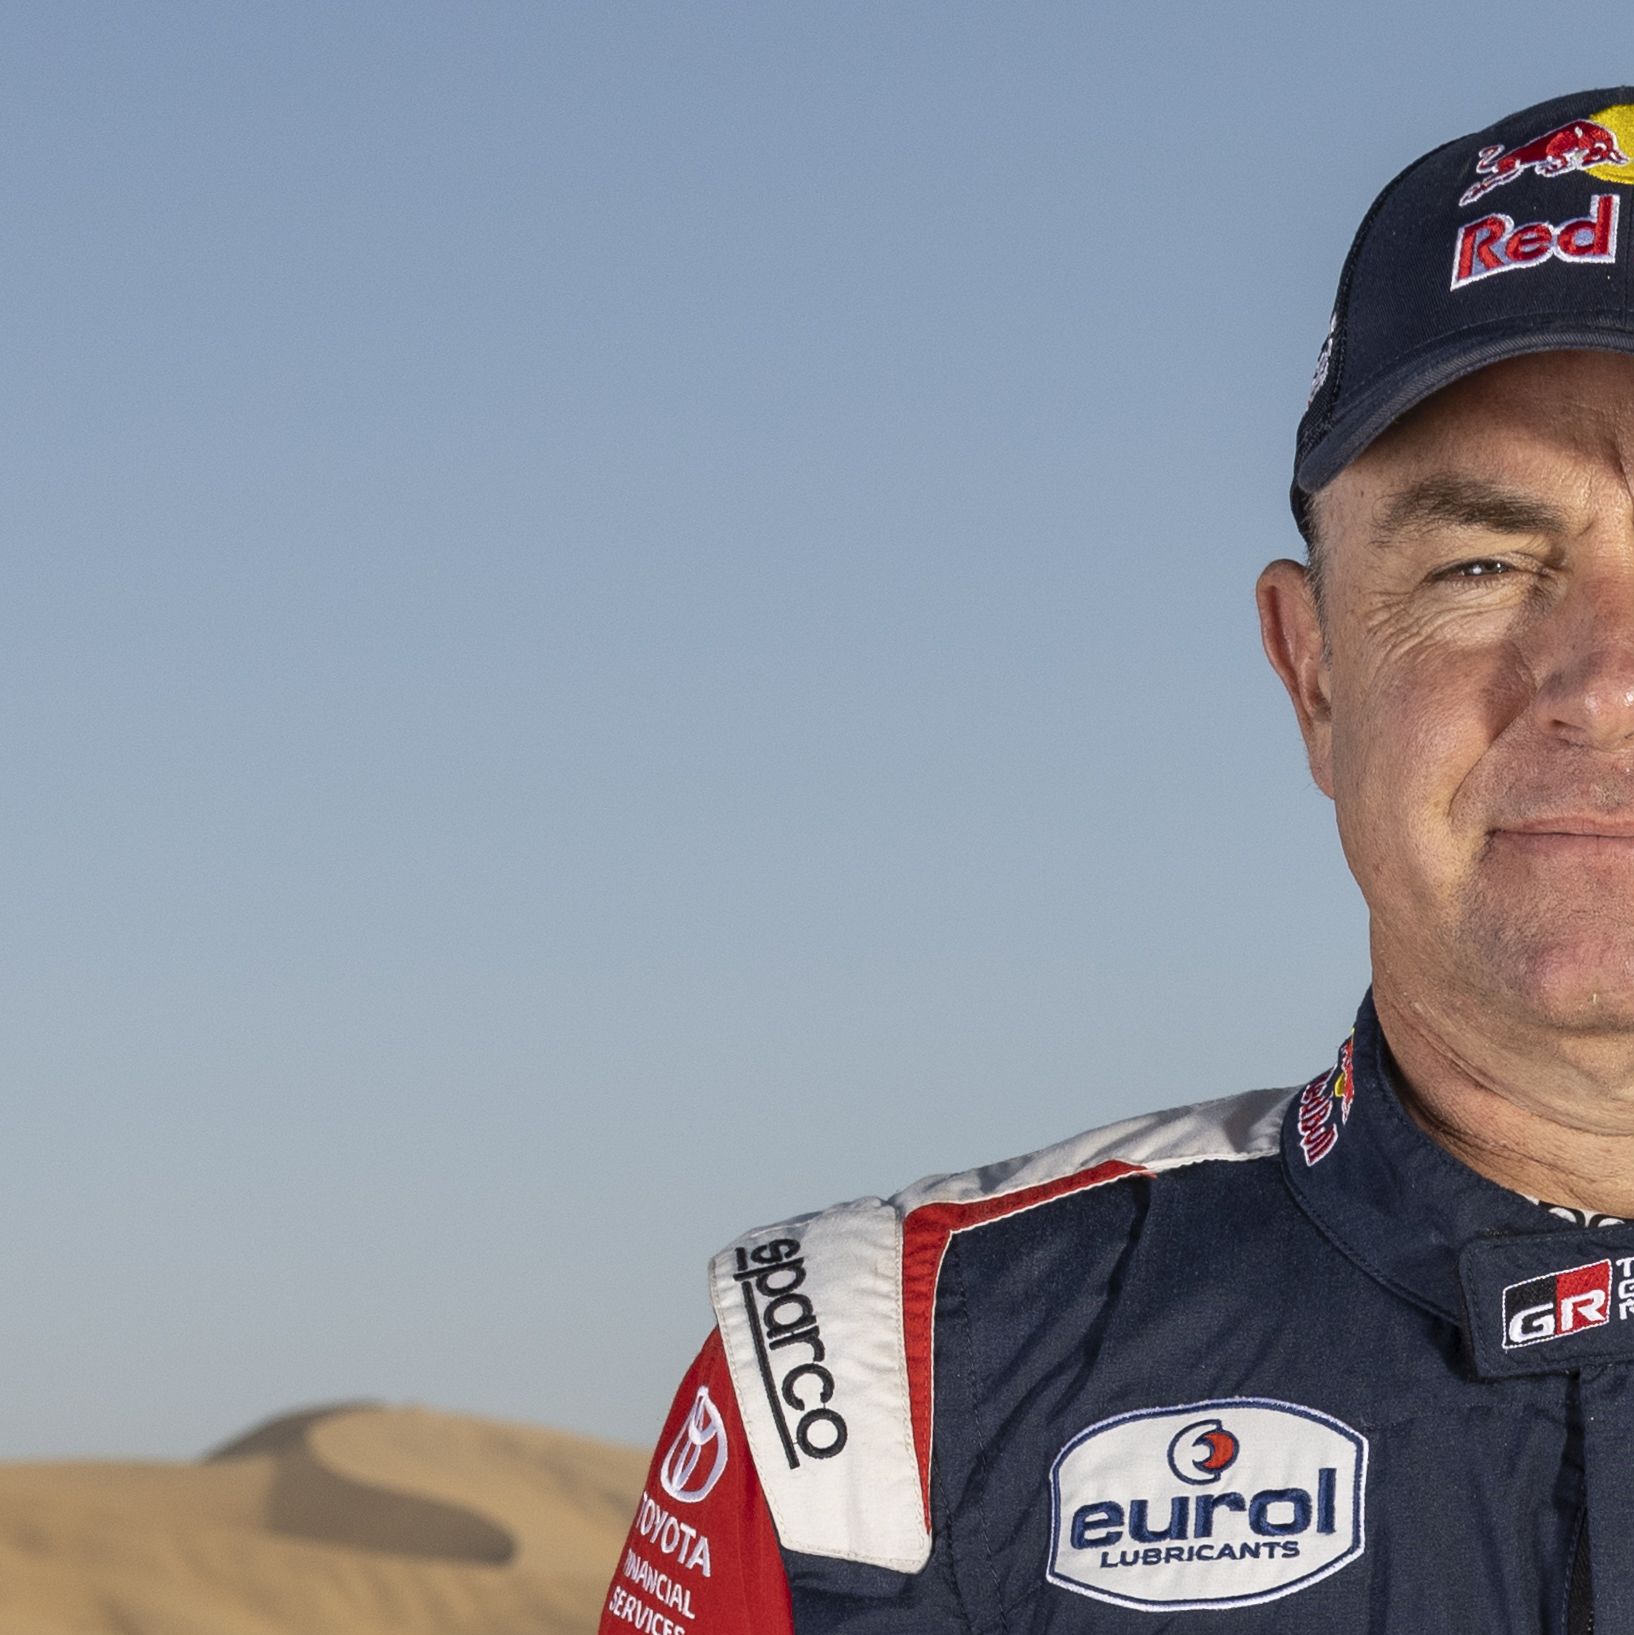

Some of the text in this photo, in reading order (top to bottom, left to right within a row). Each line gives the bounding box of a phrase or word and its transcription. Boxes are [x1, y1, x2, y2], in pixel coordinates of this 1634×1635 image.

[1450, 194, 1620, 291] Red
[733, 1239, 848, 1461] sparco
[1508, 1289, 1606, 1343] GR
[1070, 1468, 1337, 1551] eurol
[1100, 1541, 1301, 1569] LUBRICANTS
